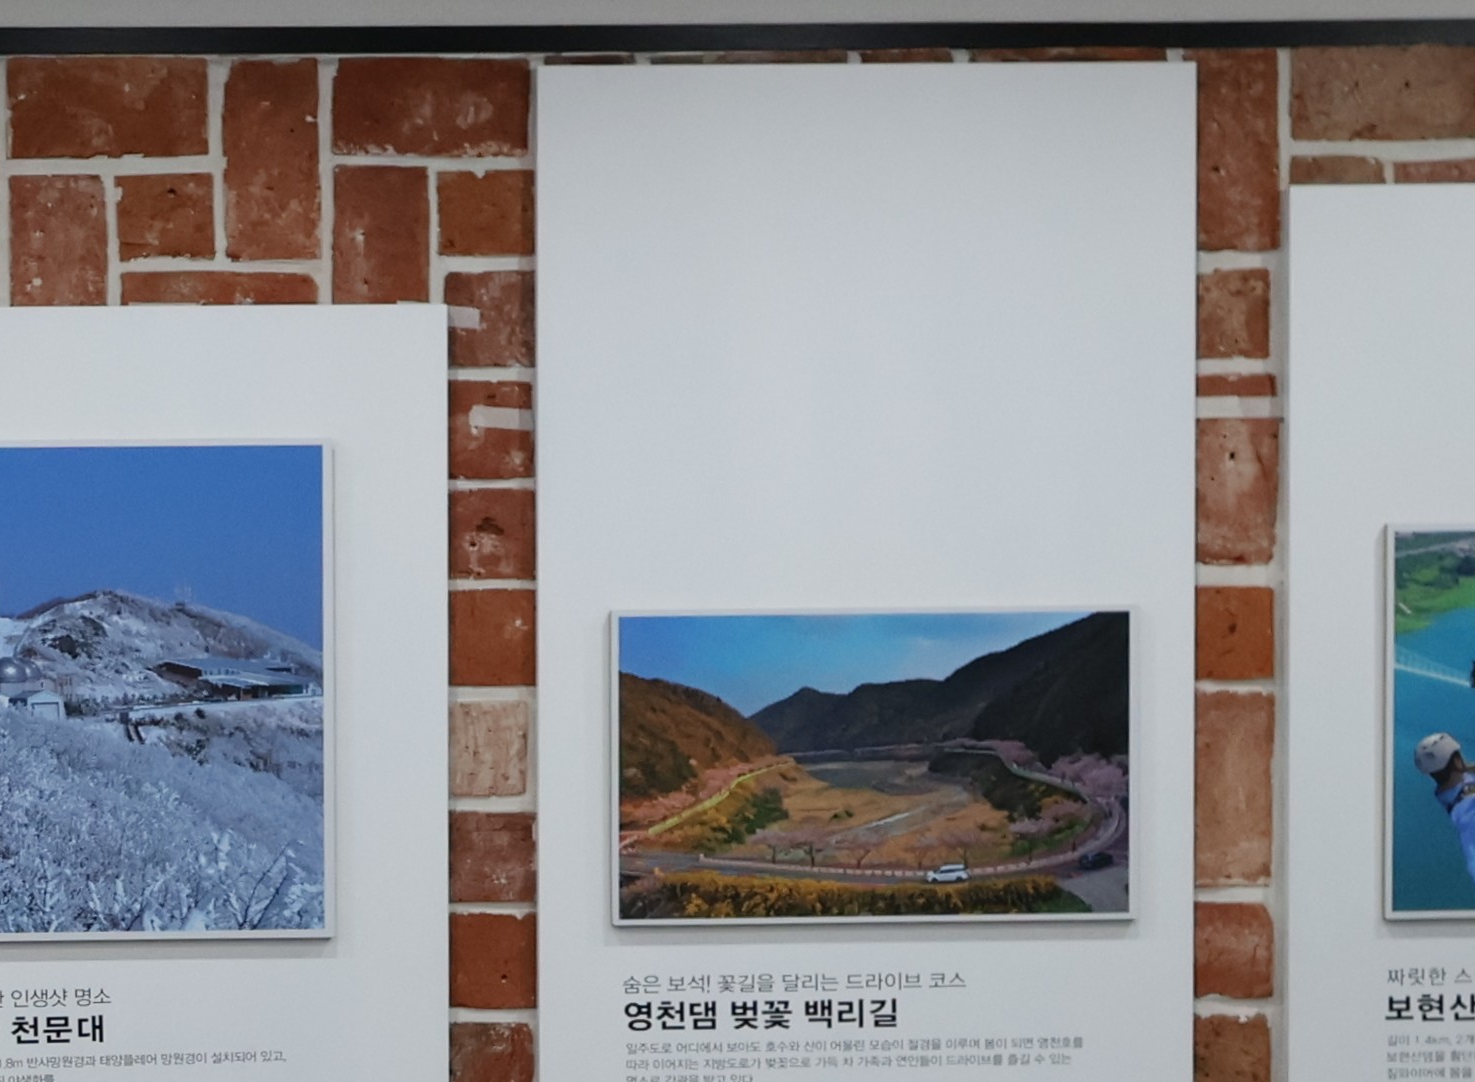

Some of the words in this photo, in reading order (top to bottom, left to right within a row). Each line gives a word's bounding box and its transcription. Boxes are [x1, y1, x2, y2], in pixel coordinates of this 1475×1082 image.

[622, 974, 662, 995] 숨은
[666, 974, 711, 994] 보석!
[717, 973, 775, 994] 꽃길을
[781, 973, 839, 993] 달리는
[846, 972, 922, 990] 드라이브
[929, 972, 966, 989] 코스
[1387, 967, 1447, 987] 짜릿한
[10, 988, 68, 1009] 인생샷
[73, 987, 111, 1008] 명소
[622, 999, 720, 1033] 영천댐
[728, 998, 793, 1031] 벚꽃
[802, 997, 900, 1030] 백리길
[9, 1014, 107, 1046] 천문대
[26, 1055, 97, 1069] 반사망원경과
[160, 1052, 208, 1066] 망원경이
[211, 1050, 258, 1065] 설치되어
